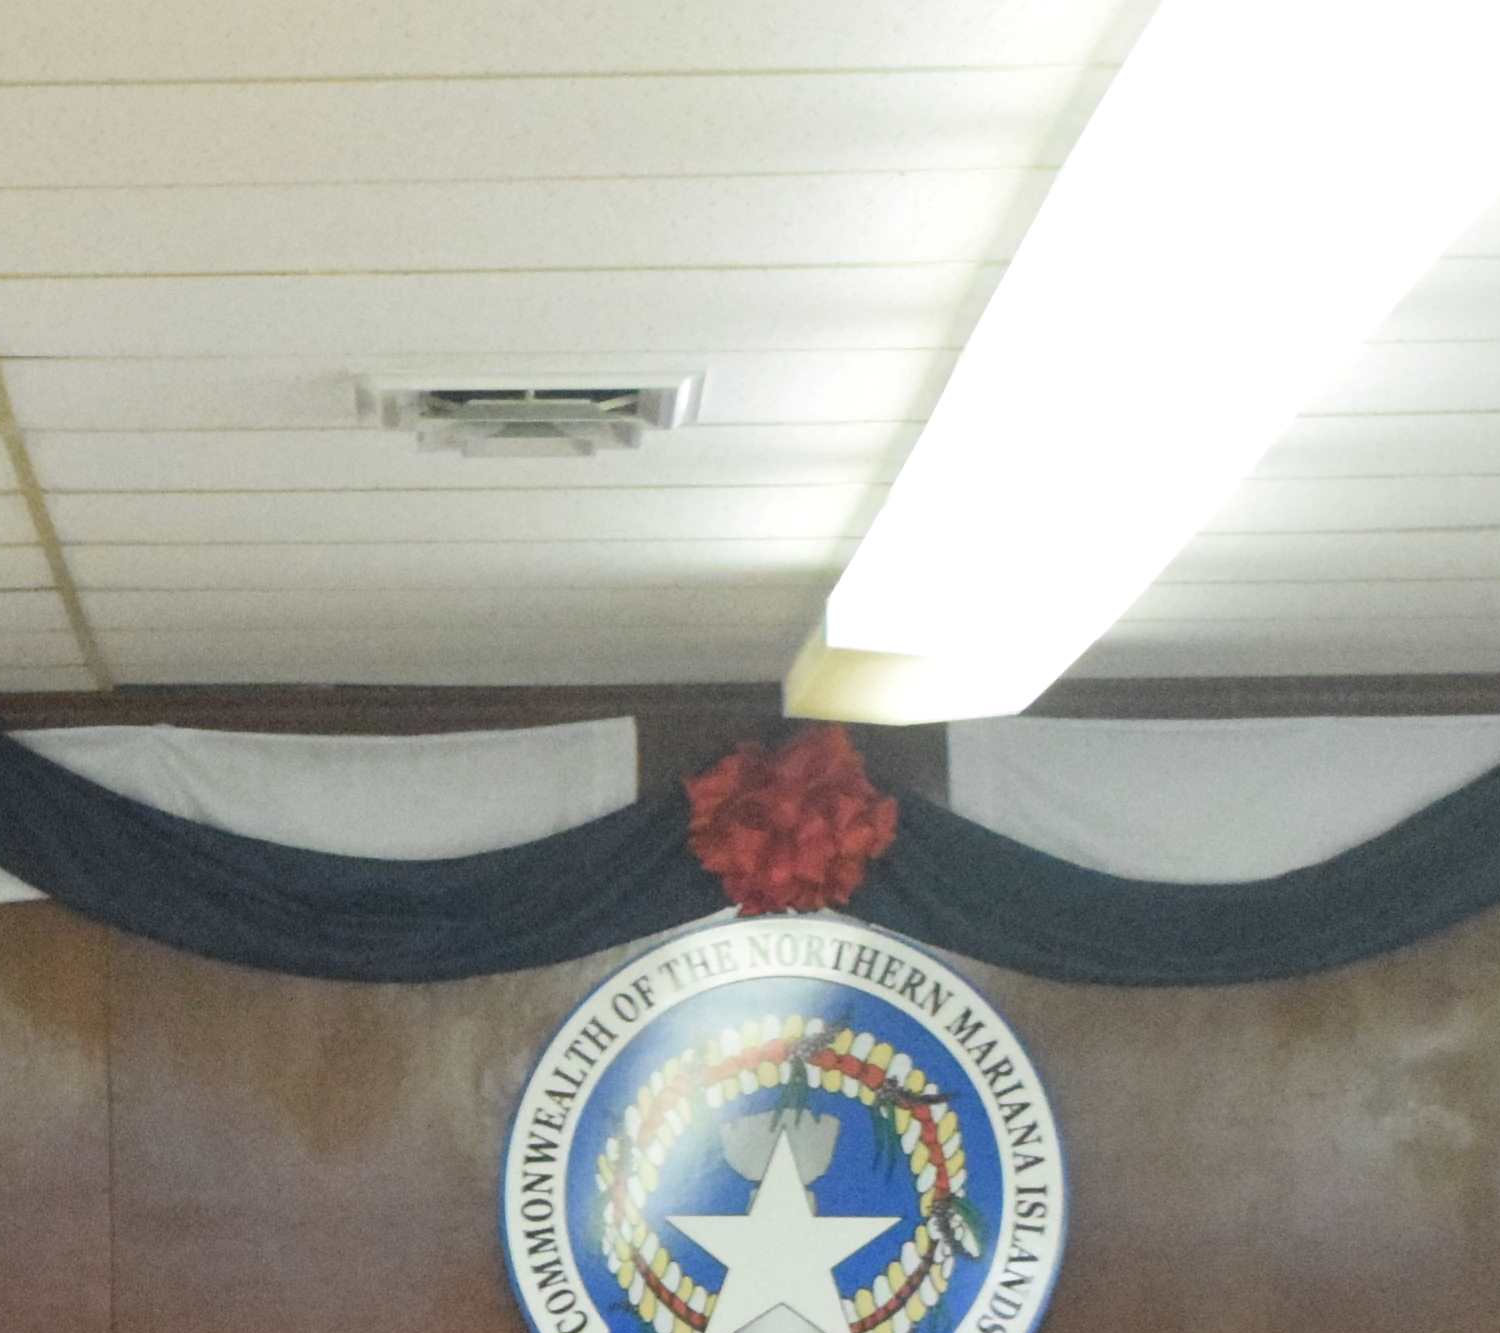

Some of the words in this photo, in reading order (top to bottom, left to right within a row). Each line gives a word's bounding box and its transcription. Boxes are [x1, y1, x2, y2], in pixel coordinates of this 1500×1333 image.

[611, 975, 657, 1025] OF
[657, 939, 739, 994] THE
[748, 933, 954, 1017] NORTHERN
[946, 1008, 1046, 1175] MARIANA
